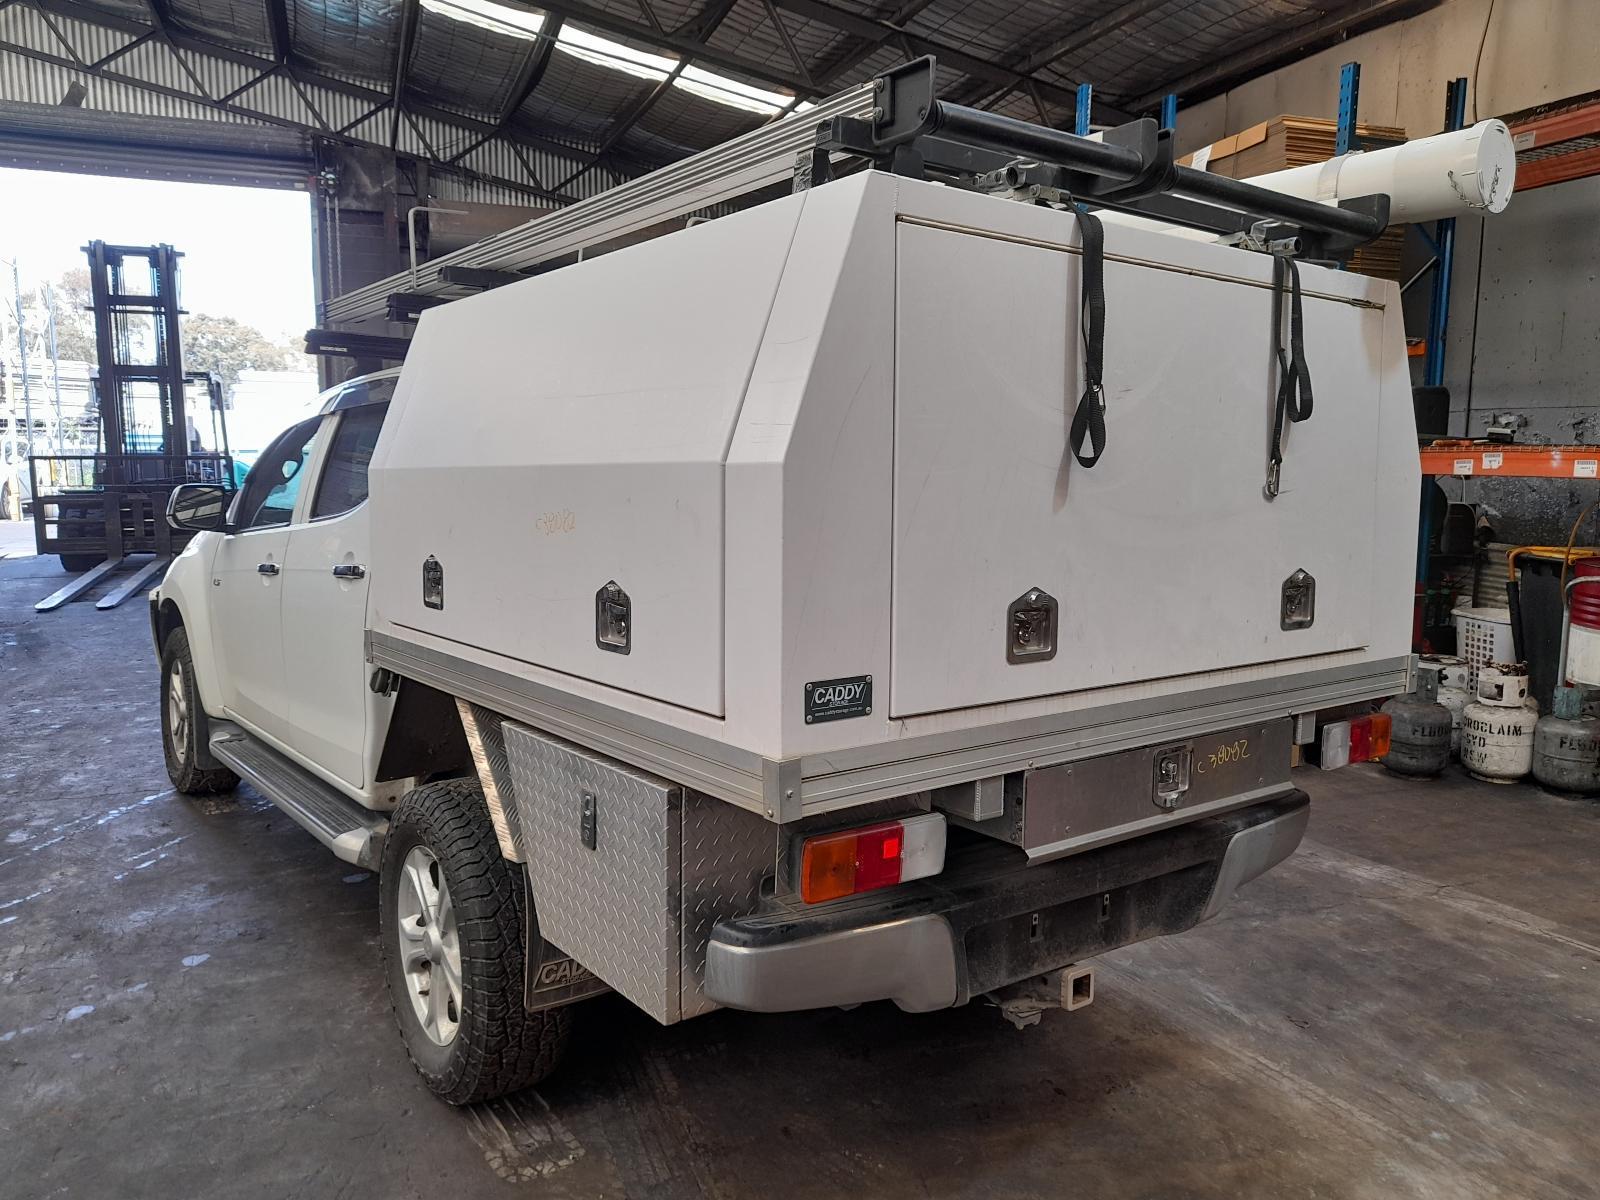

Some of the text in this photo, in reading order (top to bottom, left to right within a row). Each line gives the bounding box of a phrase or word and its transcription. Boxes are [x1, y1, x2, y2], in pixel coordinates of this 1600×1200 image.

[814, 683, 864, 704] CADDY
[1466, 733, 1486, 748] SYD
[541, 960, 592, 984] CAD
